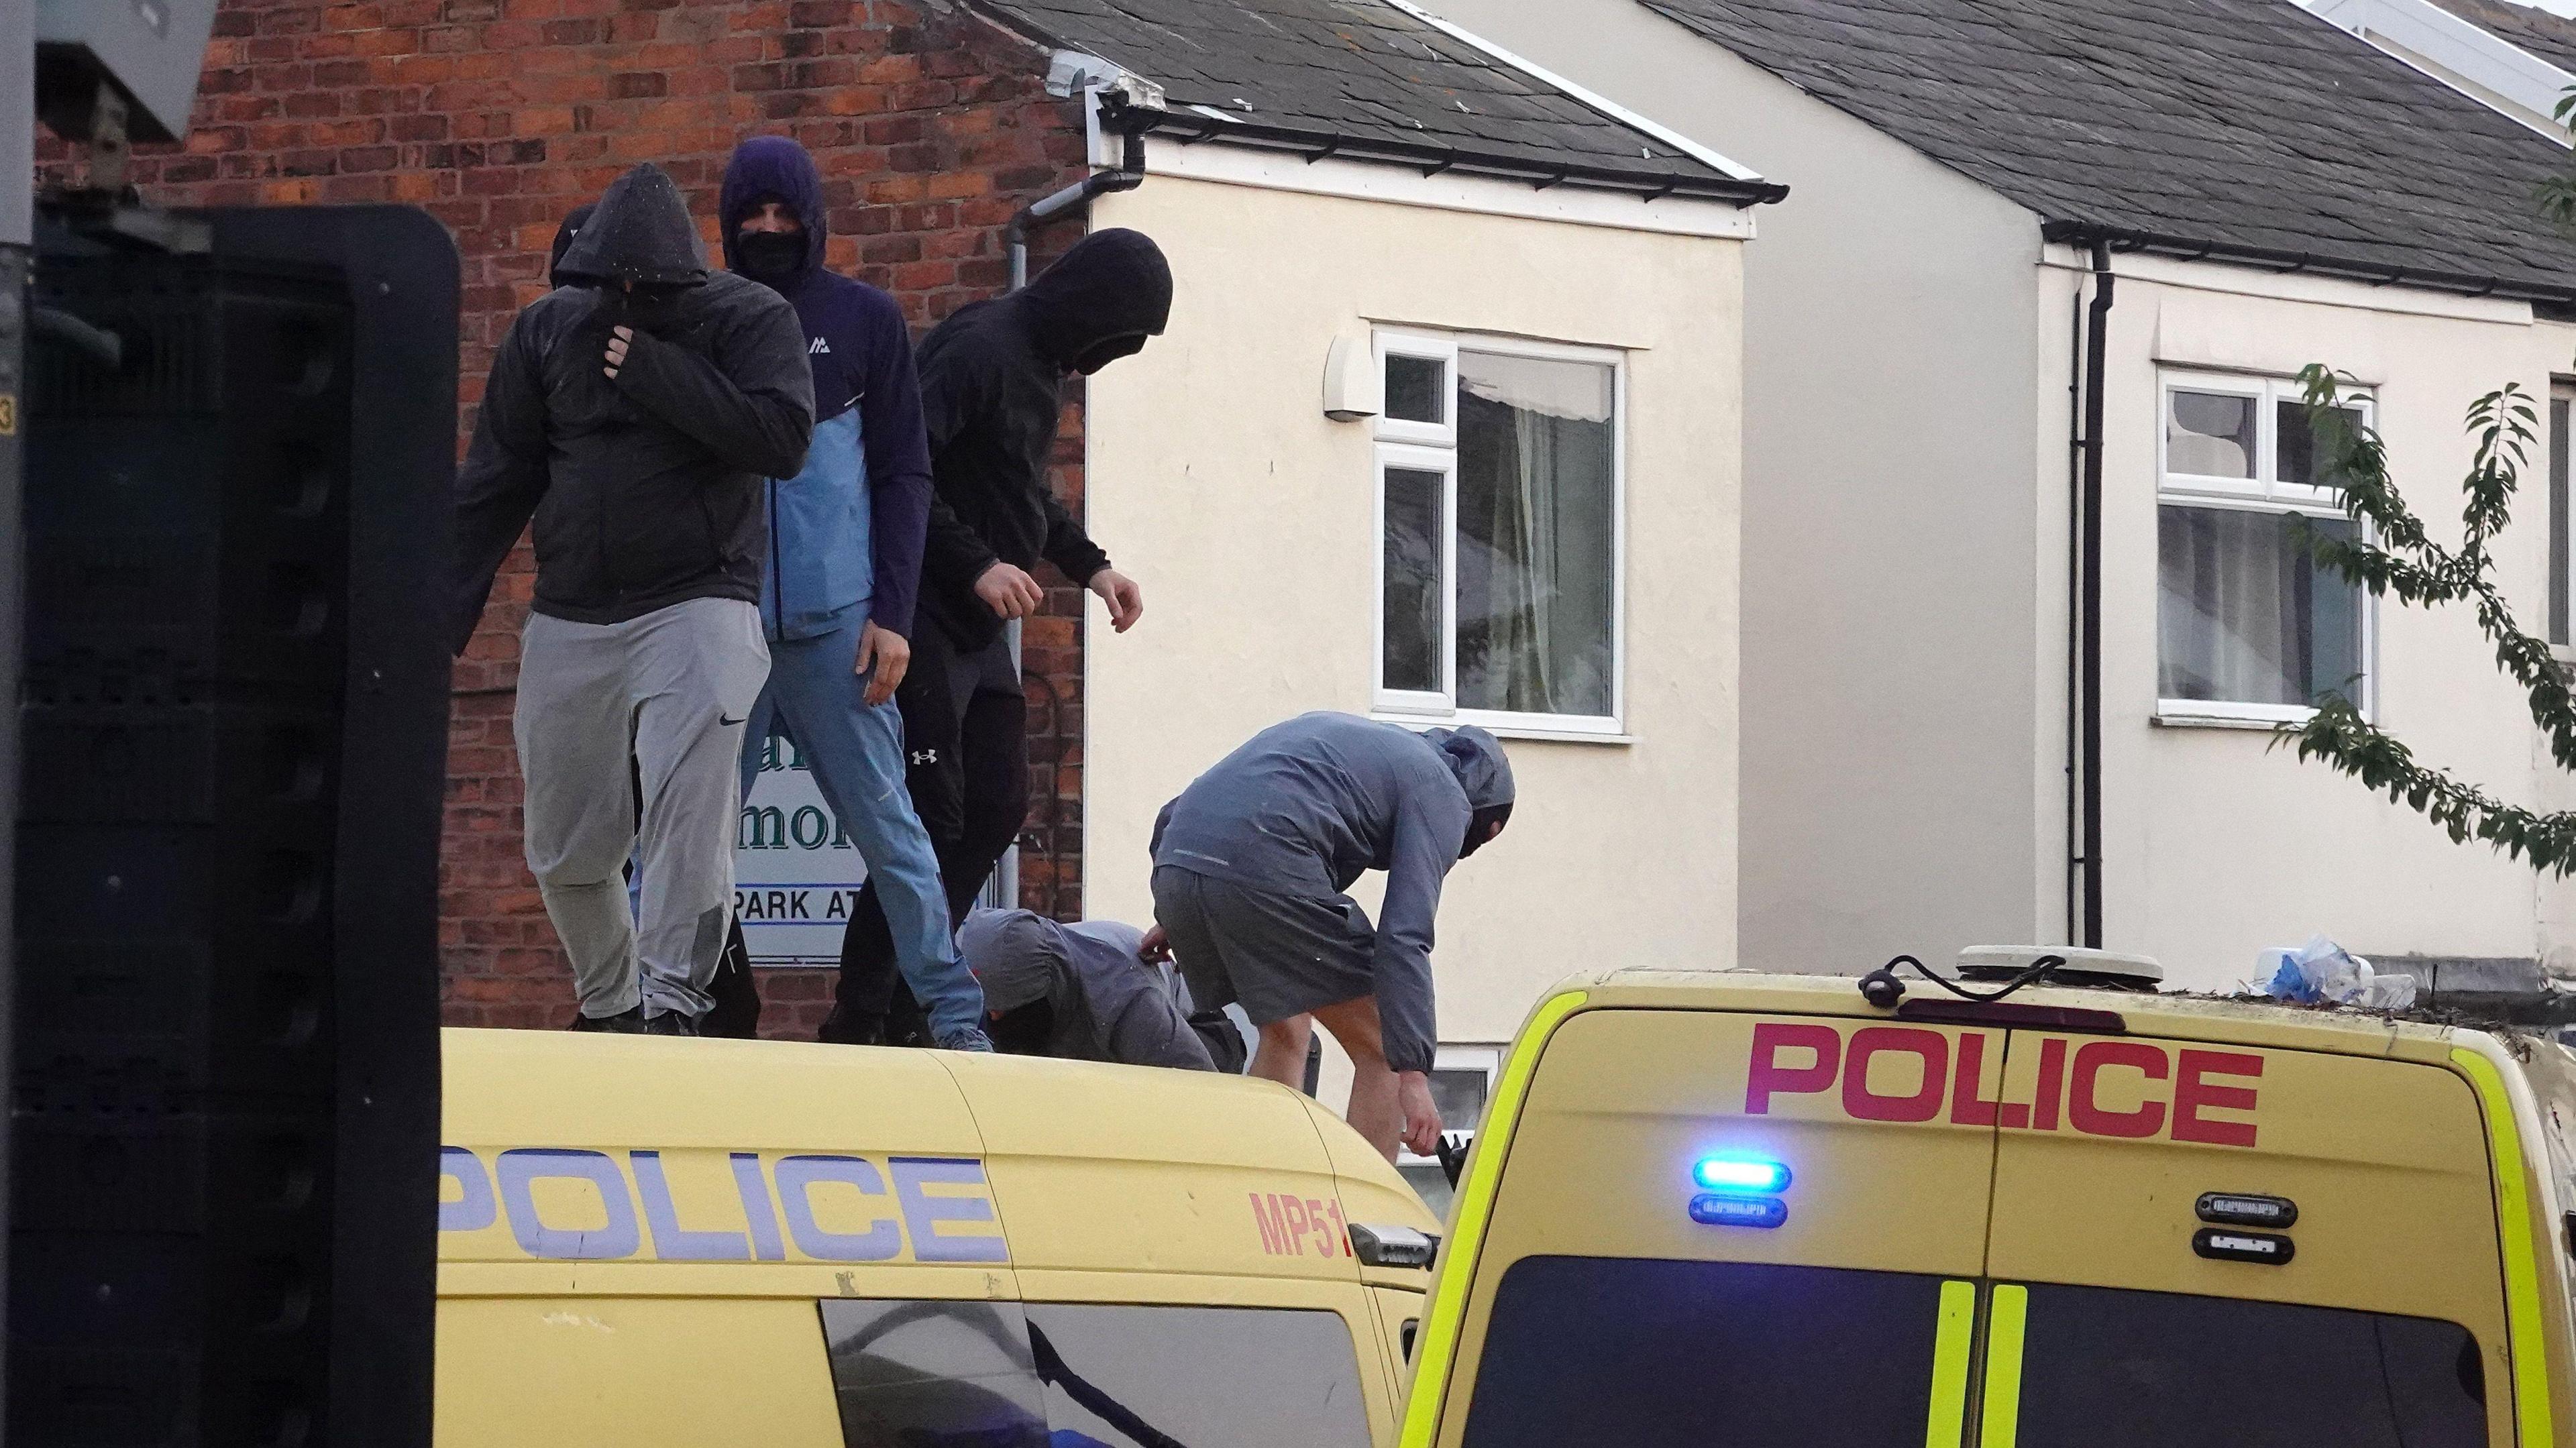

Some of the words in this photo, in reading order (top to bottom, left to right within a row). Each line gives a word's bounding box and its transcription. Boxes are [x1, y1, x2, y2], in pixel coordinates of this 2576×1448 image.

[735, 891, 810, 919] PARK
[1745, 1023, 2264, 1148] POLICE
[439, 1146, 1008, 1262] POLICE
[1248, 1192, 1352, 1258] MP51
